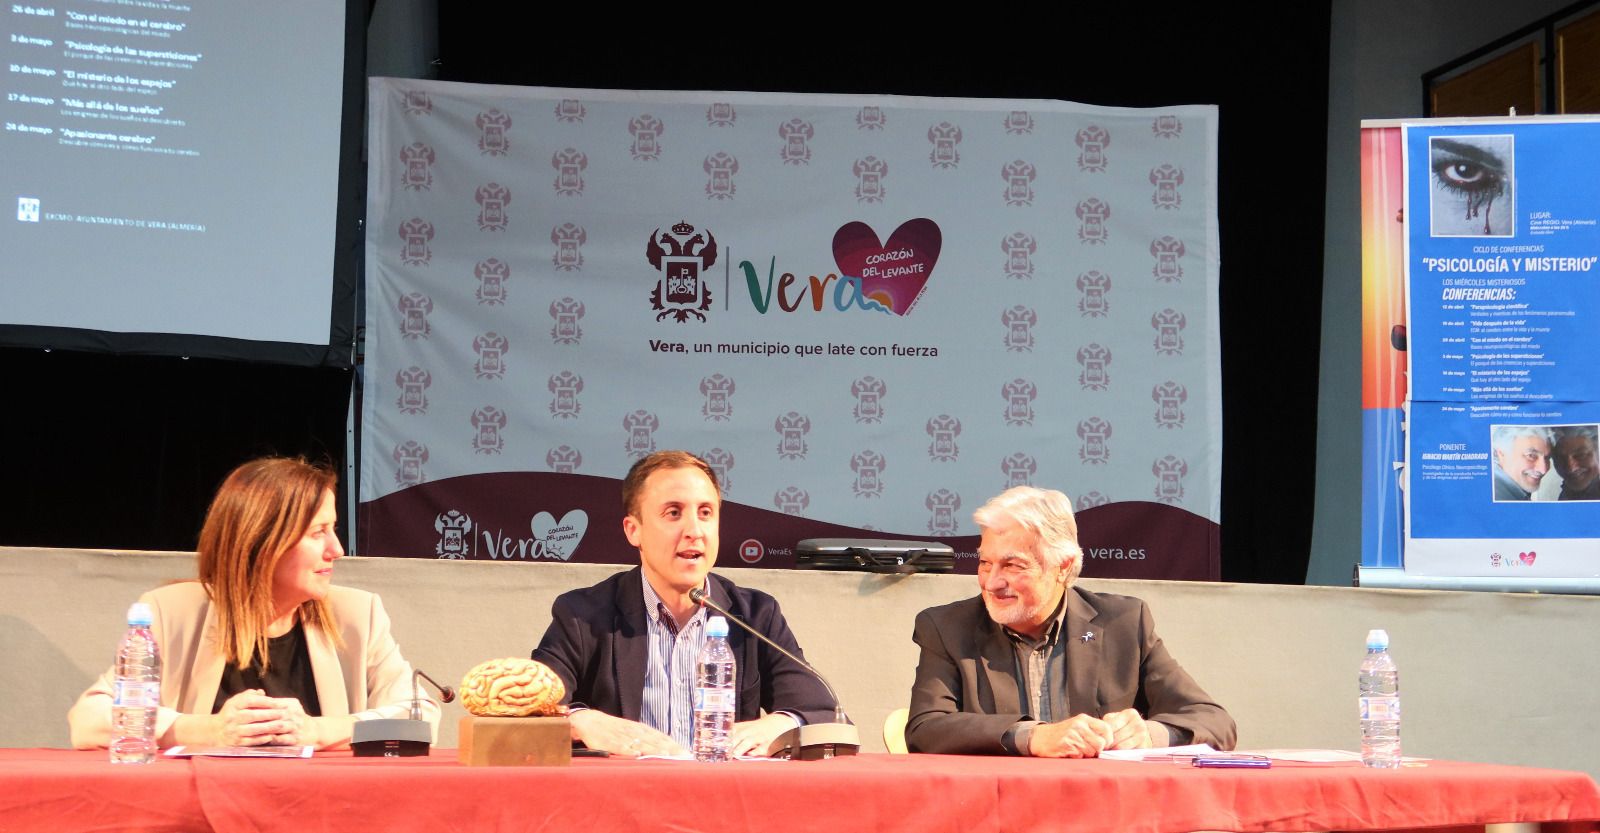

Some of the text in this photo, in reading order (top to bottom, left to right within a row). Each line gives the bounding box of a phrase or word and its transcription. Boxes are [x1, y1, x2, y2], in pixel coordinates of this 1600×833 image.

[98, 15, 126, 26] miedo
[29, 38, 54, 48] mayo
[32, 67, 56, 76] mayo
[76, 72, 112, 82] misterio
[30, 96, 54, 106] mayo
[29, 126, 53, 135] mayo
[1500, 244, 1544, 254] CONFERENCIAS
[865, 247, 914, 265] CORAZÓN
[1512, 258, 1522, 272] Y
[862, 263, 924, 279] DEL LEVANTE
[738, 255, 880, 315] Vera
[1442, 278, 1526, 286] LOS MIÉRCOLES MISTERIOSOS
[1442, 288, 1517, 301] CONFERENCIAS:
[648, 340, 938, 358] Vera, un municipio que late con fuerza
[1440, 443, 1468, 451] PONENTE
[482, 528, 550, 560] Vera
[768, 548, 792, 556] VeraEs
[1089, 548, 1146, 560] vera.es
